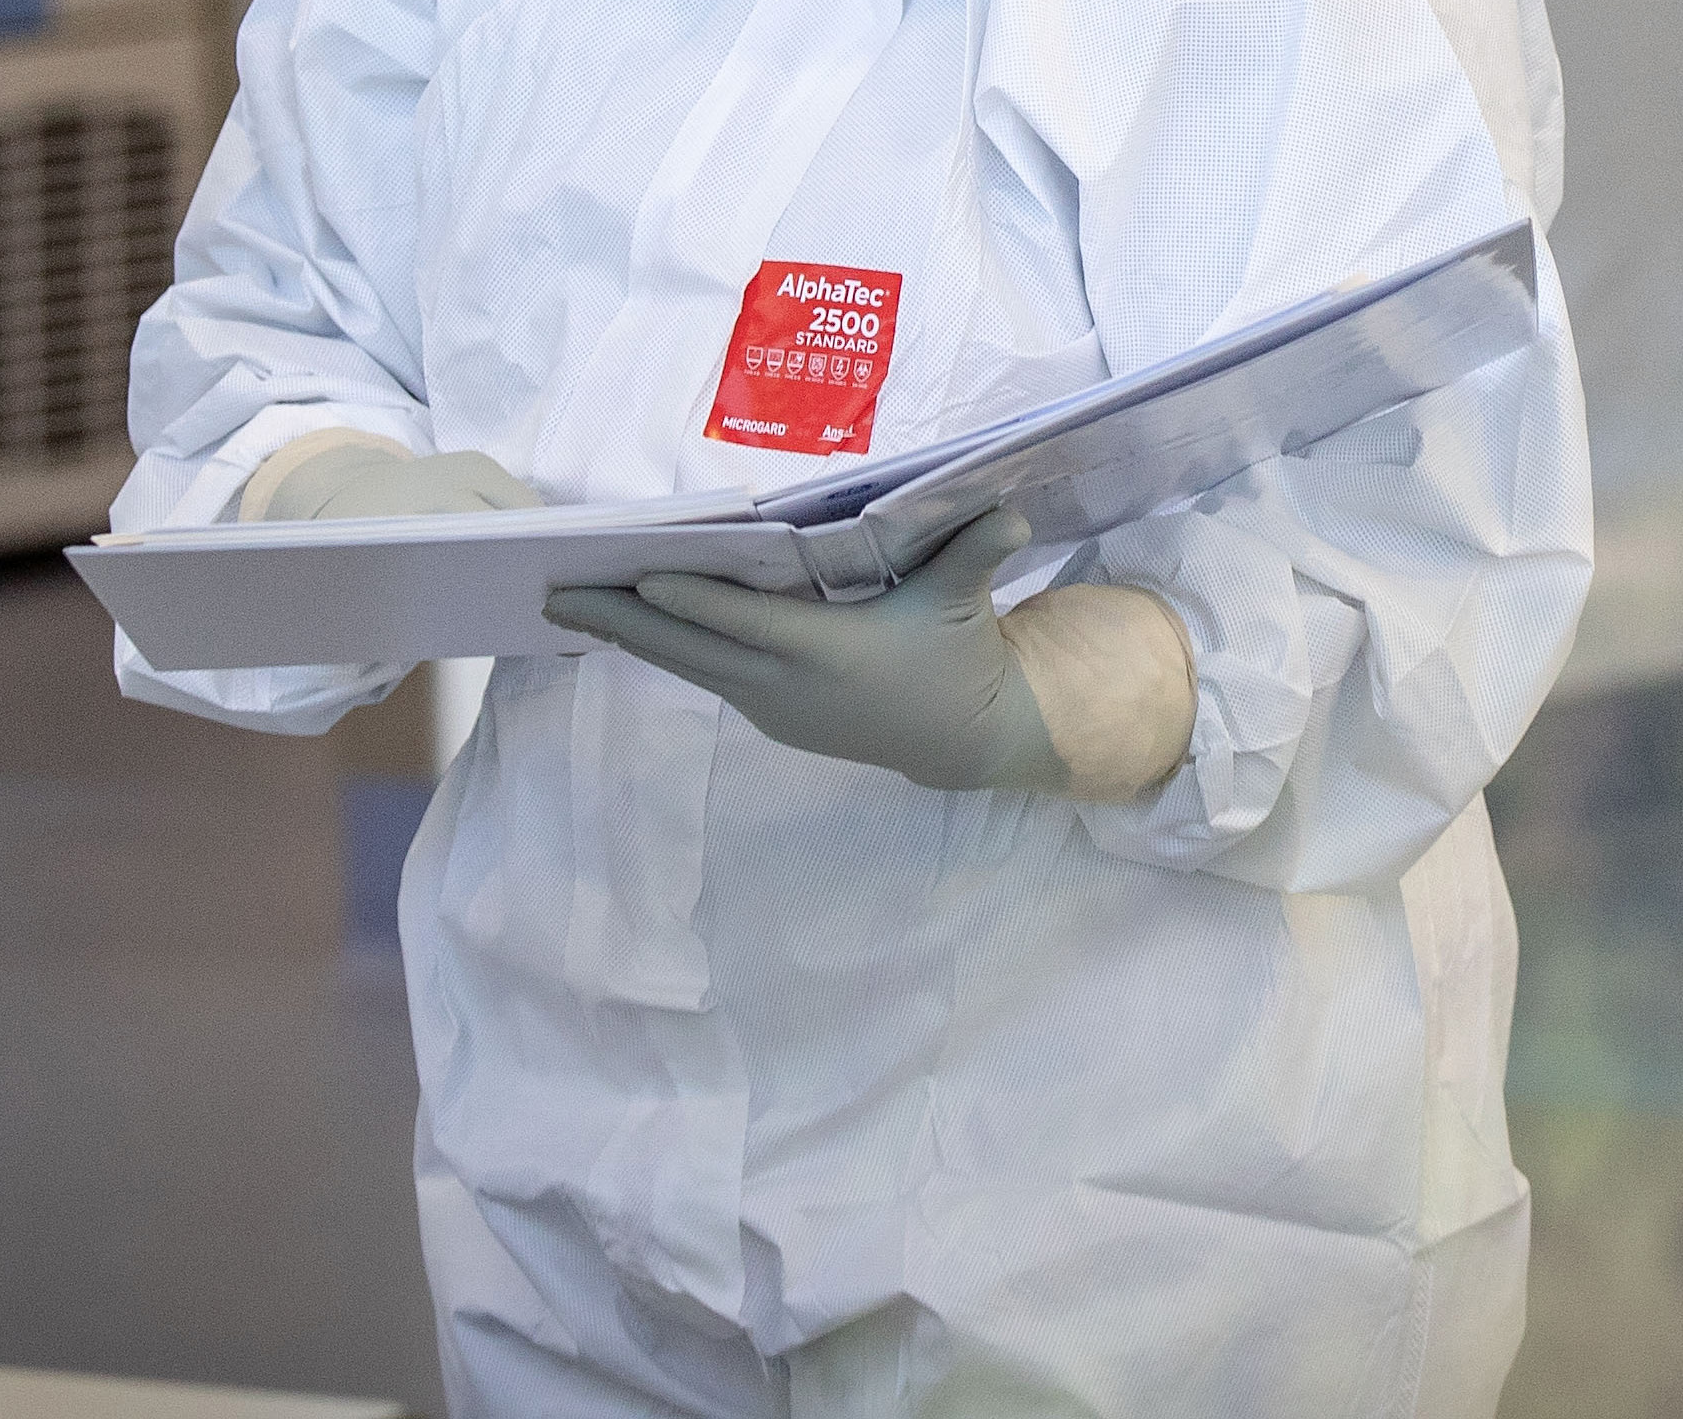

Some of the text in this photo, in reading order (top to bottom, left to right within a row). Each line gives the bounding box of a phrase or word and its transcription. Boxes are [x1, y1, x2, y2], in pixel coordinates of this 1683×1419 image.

[809, 307, 880, 338] 2500
[796, 331, 878, 355] STANDARD
[722, 415, 787, 436] MICROGARD
